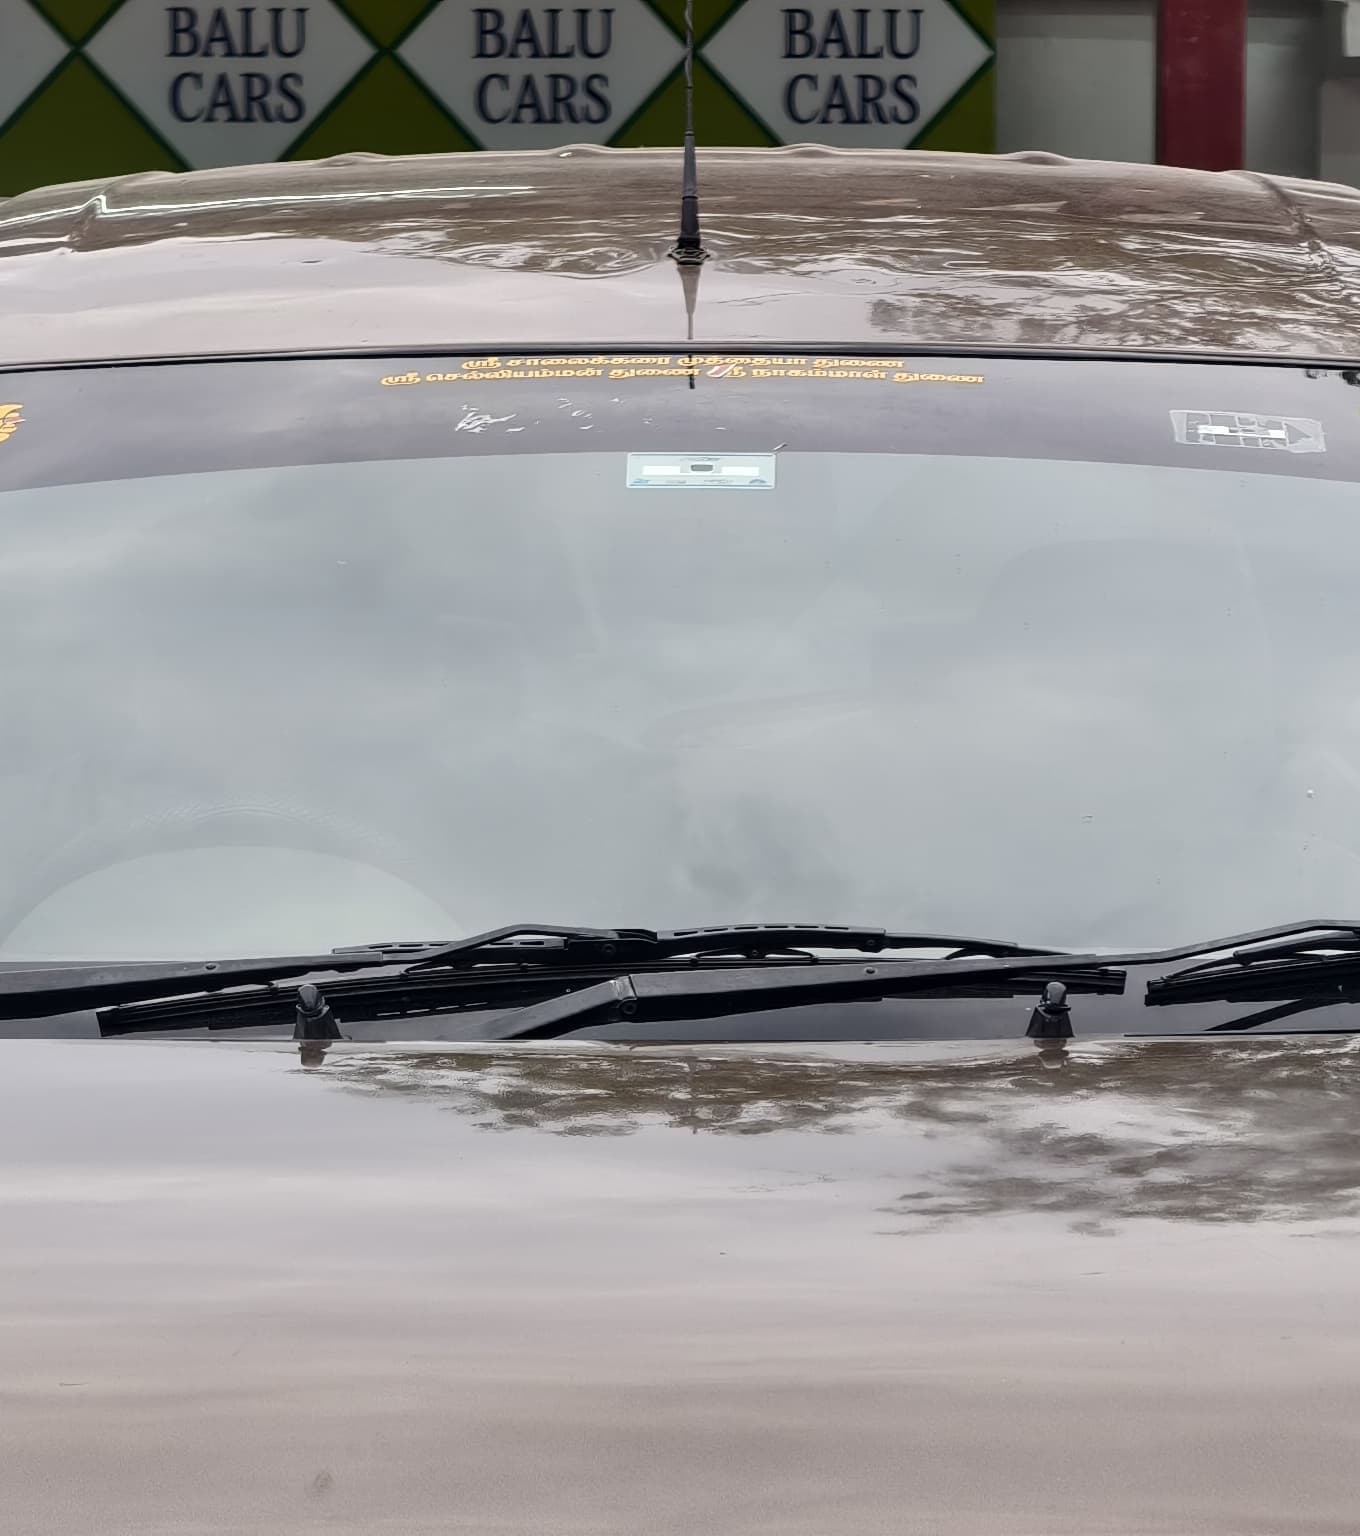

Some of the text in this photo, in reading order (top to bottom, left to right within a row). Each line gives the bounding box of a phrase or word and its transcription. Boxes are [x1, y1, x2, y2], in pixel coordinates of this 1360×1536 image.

[166, 6, 309, 59] BALU
[472, 8, 614, 60] BALU
[781, 8, 923, 60] BALU
[169, 72, 306, 123] CARS
[475, 73, 612, 124] CARS
[784, 73, 920, 124] CARS
